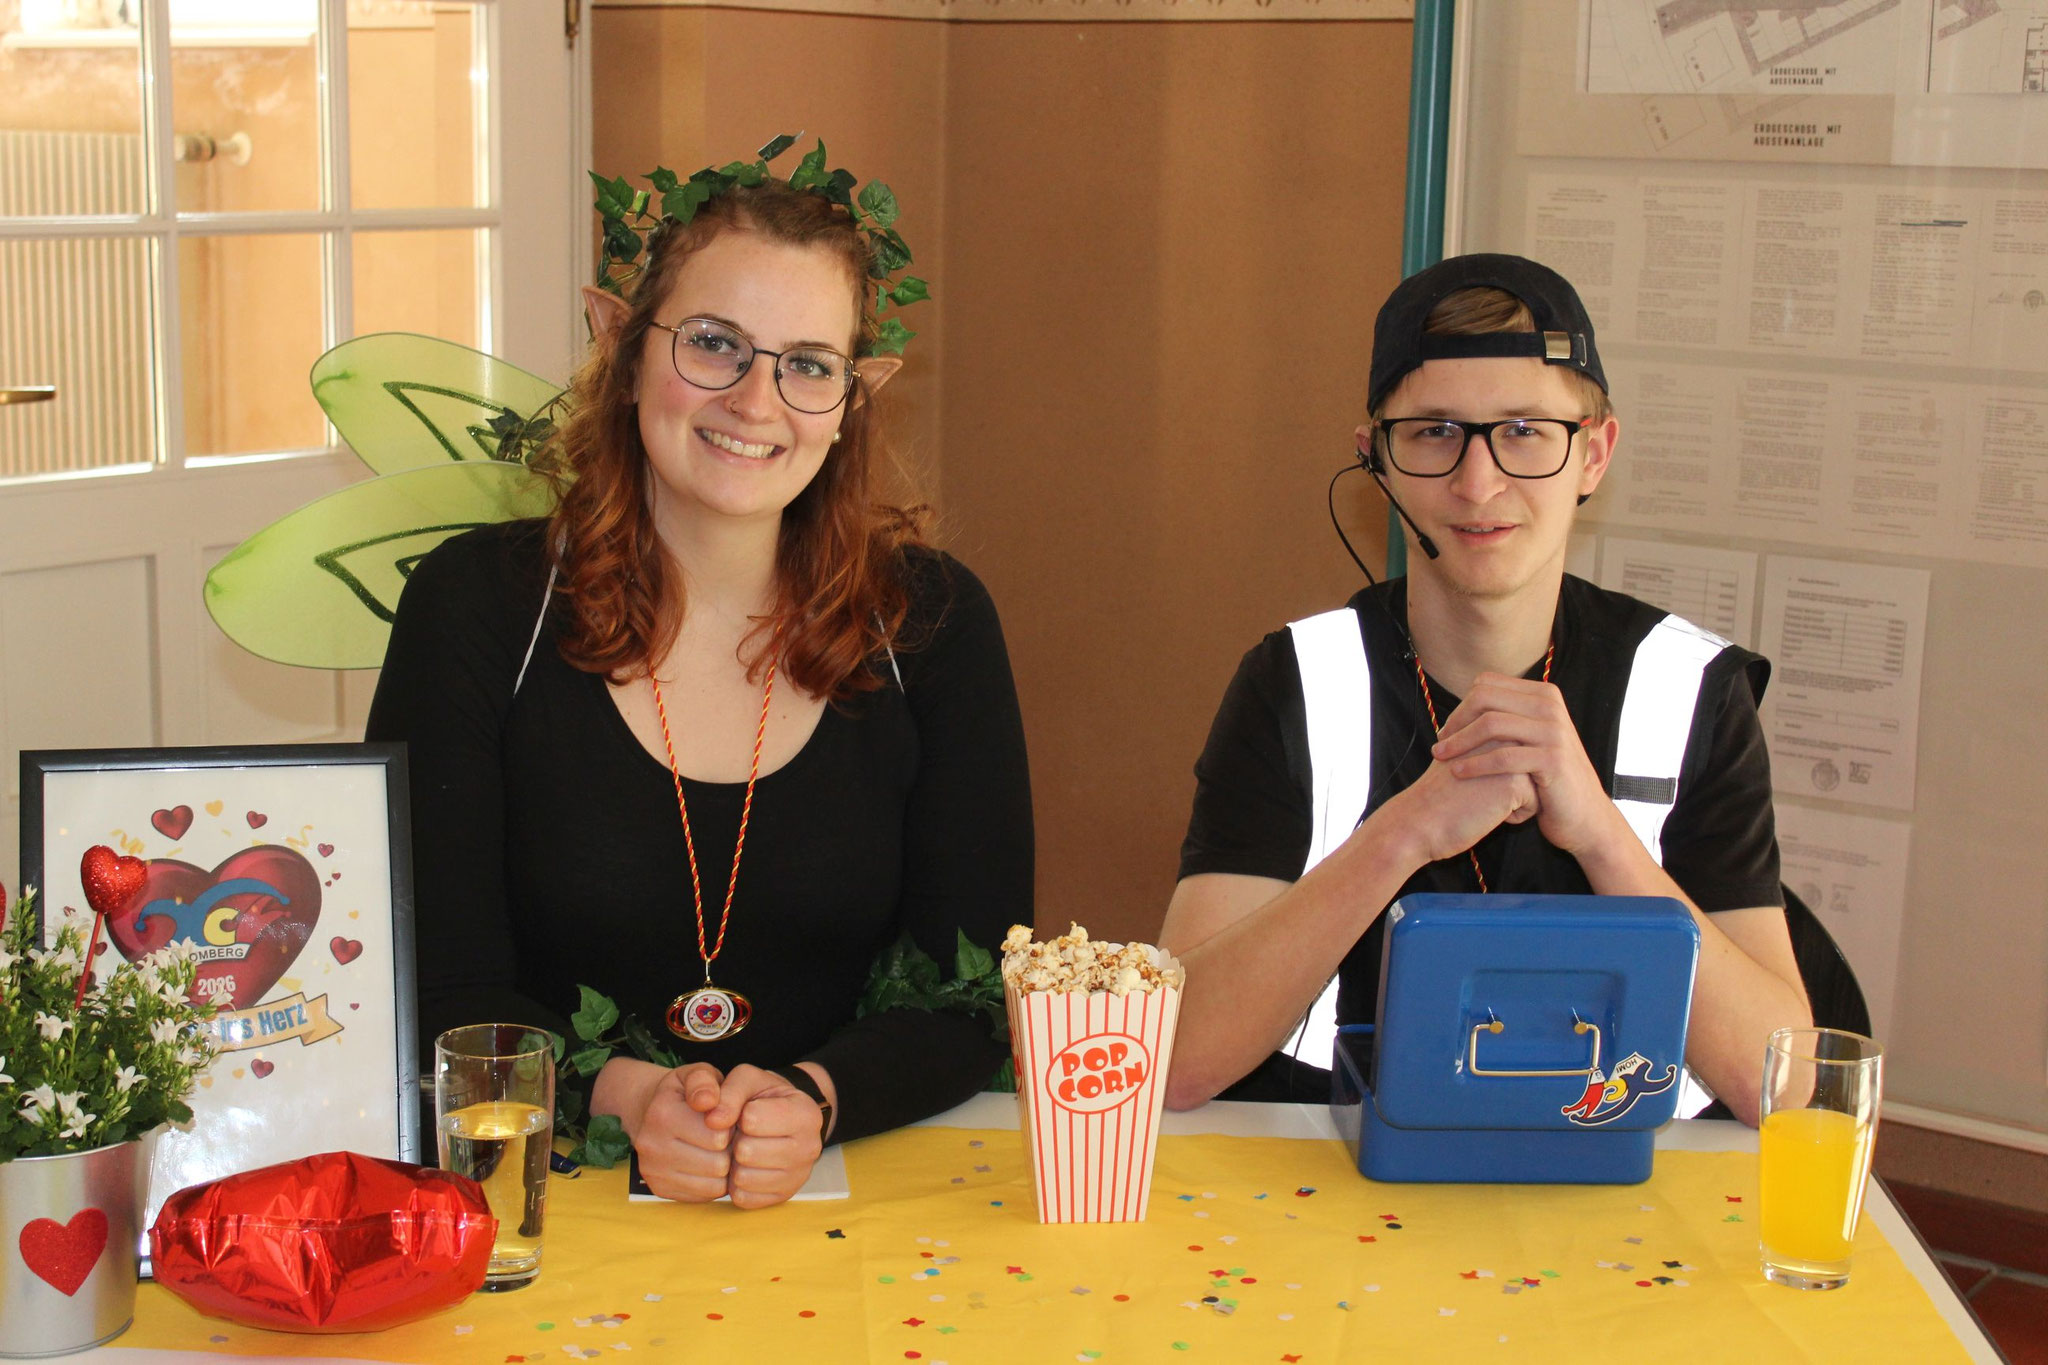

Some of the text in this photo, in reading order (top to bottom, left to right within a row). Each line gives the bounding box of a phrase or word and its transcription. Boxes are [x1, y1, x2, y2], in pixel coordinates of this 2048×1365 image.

[1825, 67, 1837, 76] MIT
[1769, 77, 1824, 86] AUSSENANLAGE
[1753, 123, 1842, 135] ERDGESCHOSS MIT
[1753, 137, 1825, 147] AUSSENANLAGE
[187, 947, 244, 962] OMBERG
[257, 1001, 308, 1036] Herz
[1061, 1042, 1129, 1077] POP
[1057, 1061, 1145, 1103] CORN
